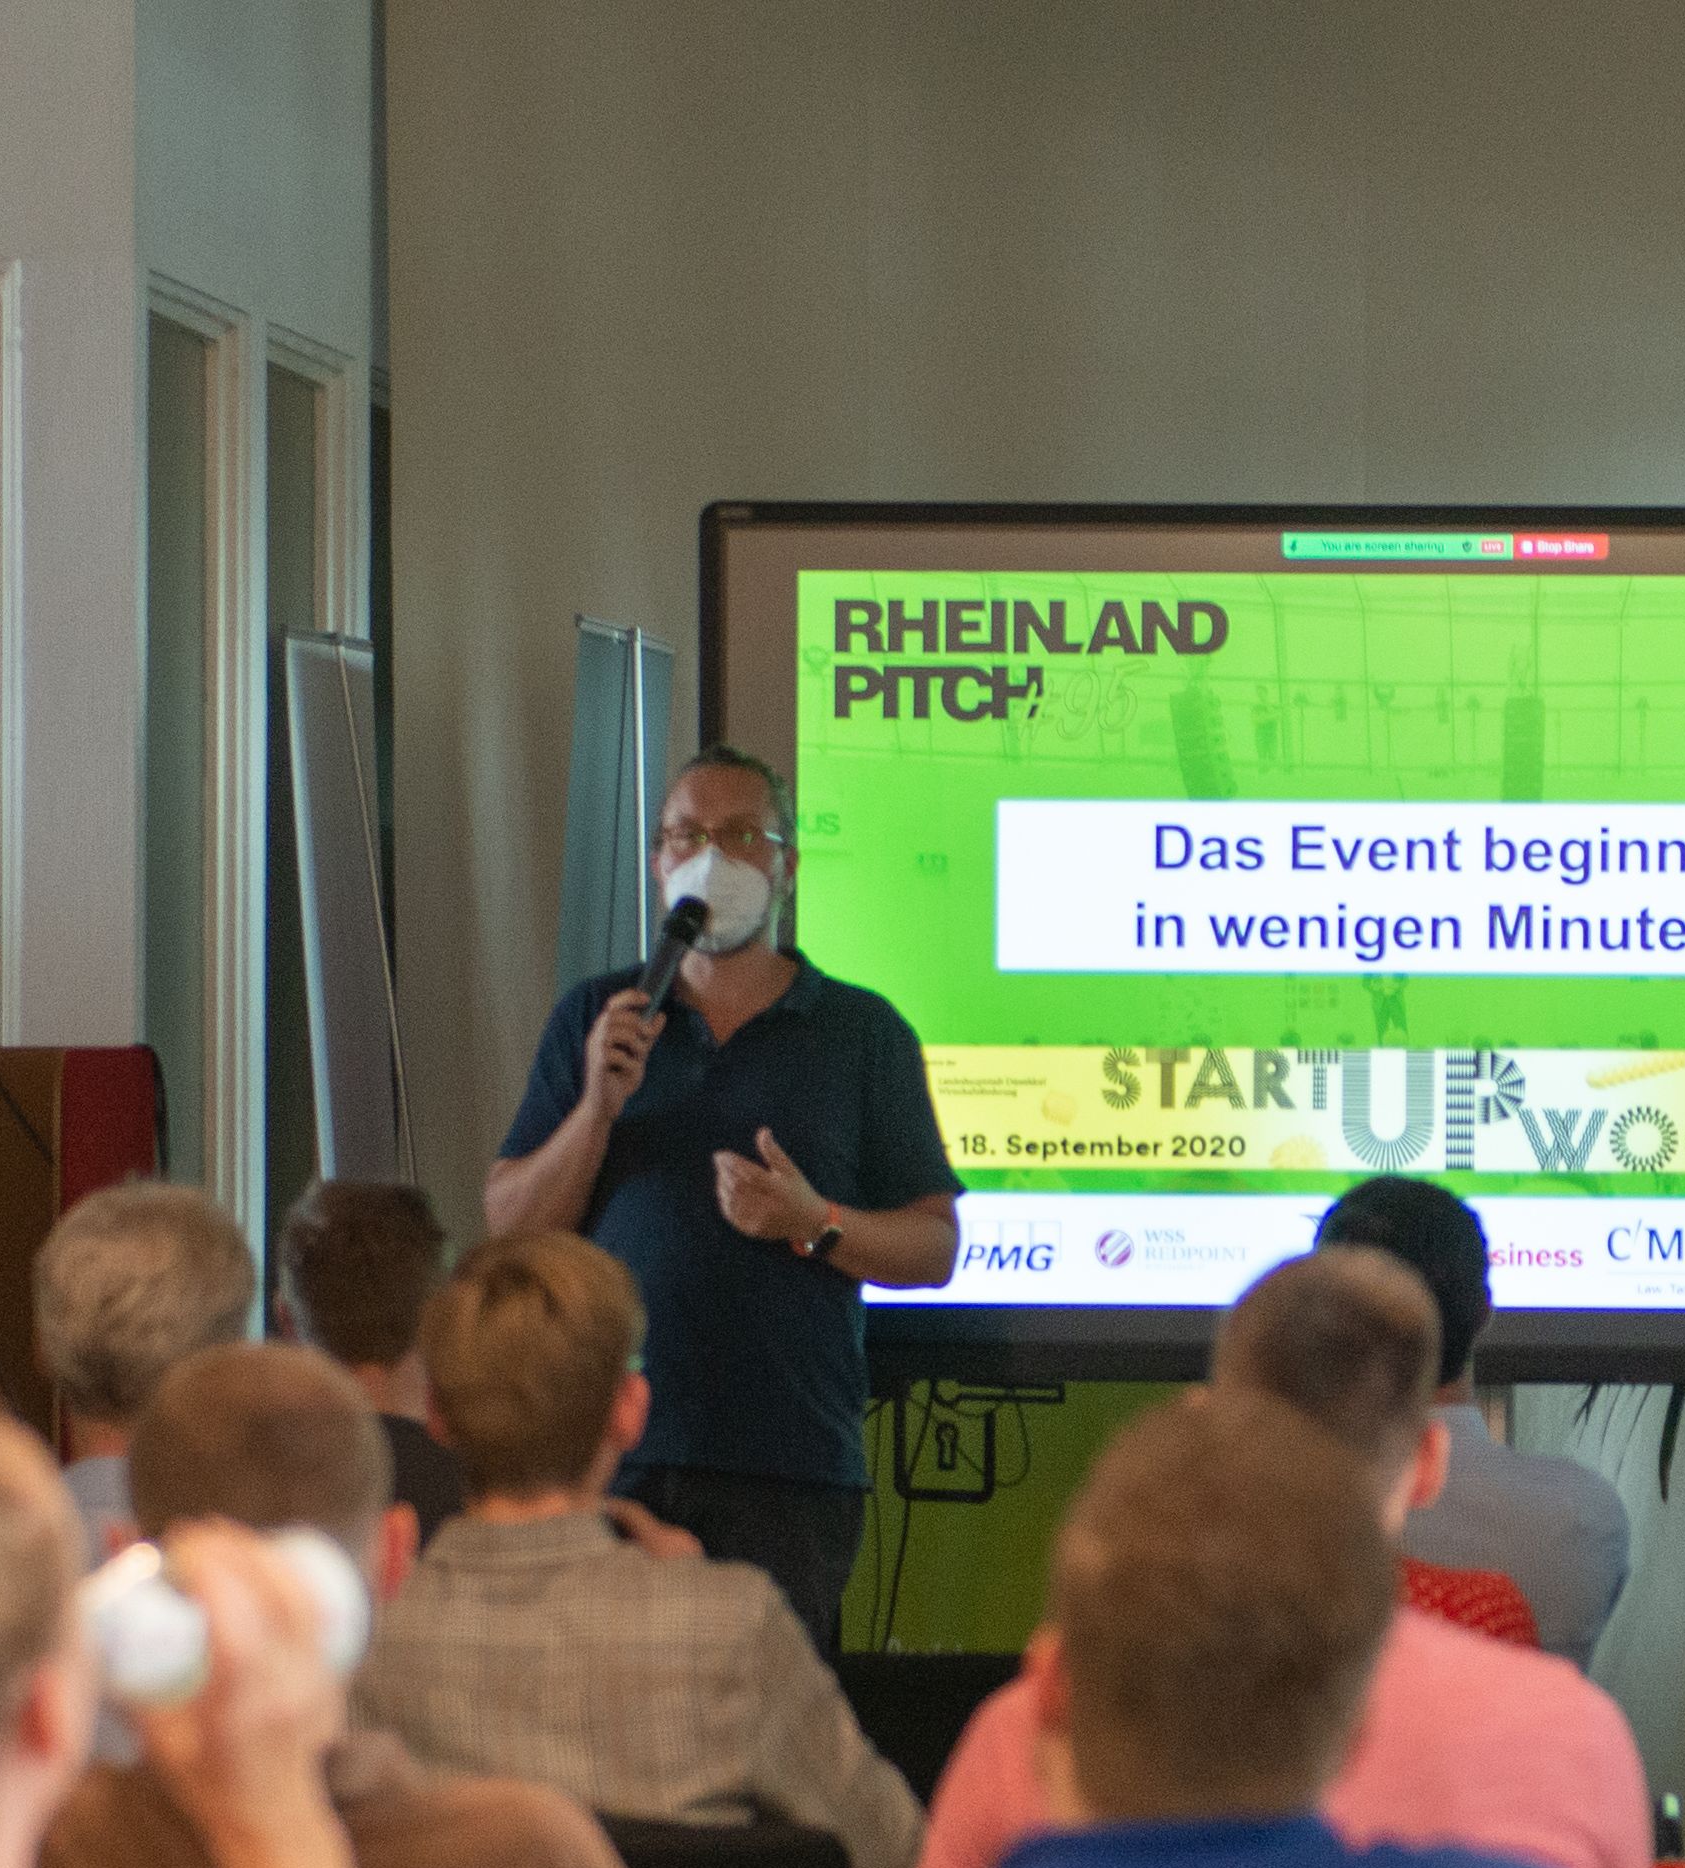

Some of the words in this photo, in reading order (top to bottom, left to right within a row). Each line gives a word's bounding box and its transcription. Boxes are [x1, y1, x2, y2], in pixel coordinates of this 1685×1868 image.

[1321, 539, 1339, 552] You
[1344, 542, 1360, 552] are
[1364, 541, 1401, 552] screen
[1405, 539, 1444, 554] sharing
[1537, 540, 1562, 555] Stop
[1564, 540, 1594, 553] Share
[834, 600, 1229, 655] RHEINLAND
[834, 666, 1044, 721] PITCH
[1154, 824, 1265, 871] Das
[1291, 824, 1462, 872] Event
[1135, 902, 1185, 948] in
[1210, 904, 1462, 961] wenigen
[960, 1133, 996, 1156] 18.
[1006, 1134, 1162, 1160] September
[1172, 1136, 1246, 1157] 2020
[963, 1245, 1054, 1271] PMG
[1489, 1242, 1584, 1267] siness
